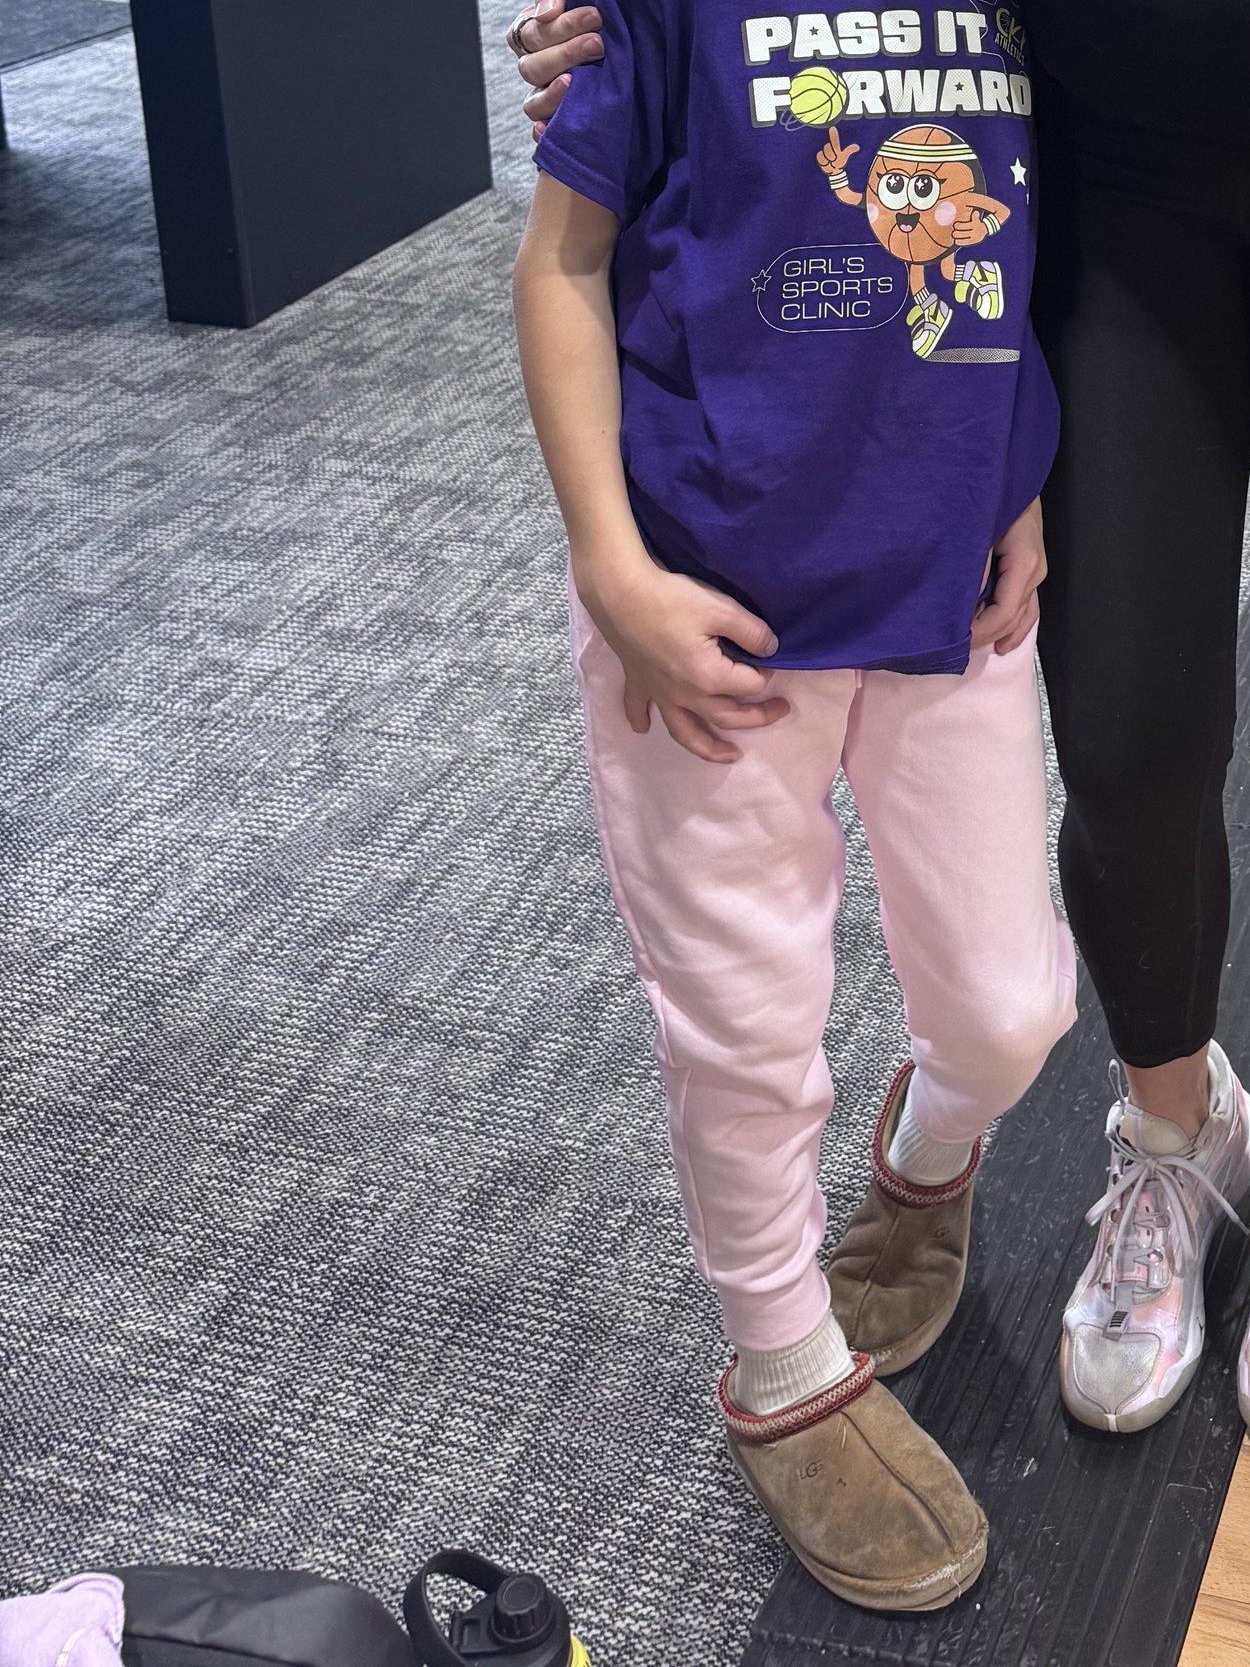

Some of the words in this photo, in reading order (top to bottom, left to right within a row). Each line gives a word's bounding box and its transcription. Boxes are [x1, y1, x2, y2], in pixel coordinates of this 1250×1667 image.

[745, 9, 921, 63] PASS
[937, 9, 986, 54] IT
[782, 256, 865, 275] GIRL'S
[781, 276, 894, 299] SPORTS
[780, 300, 872, 321] CLINIC
